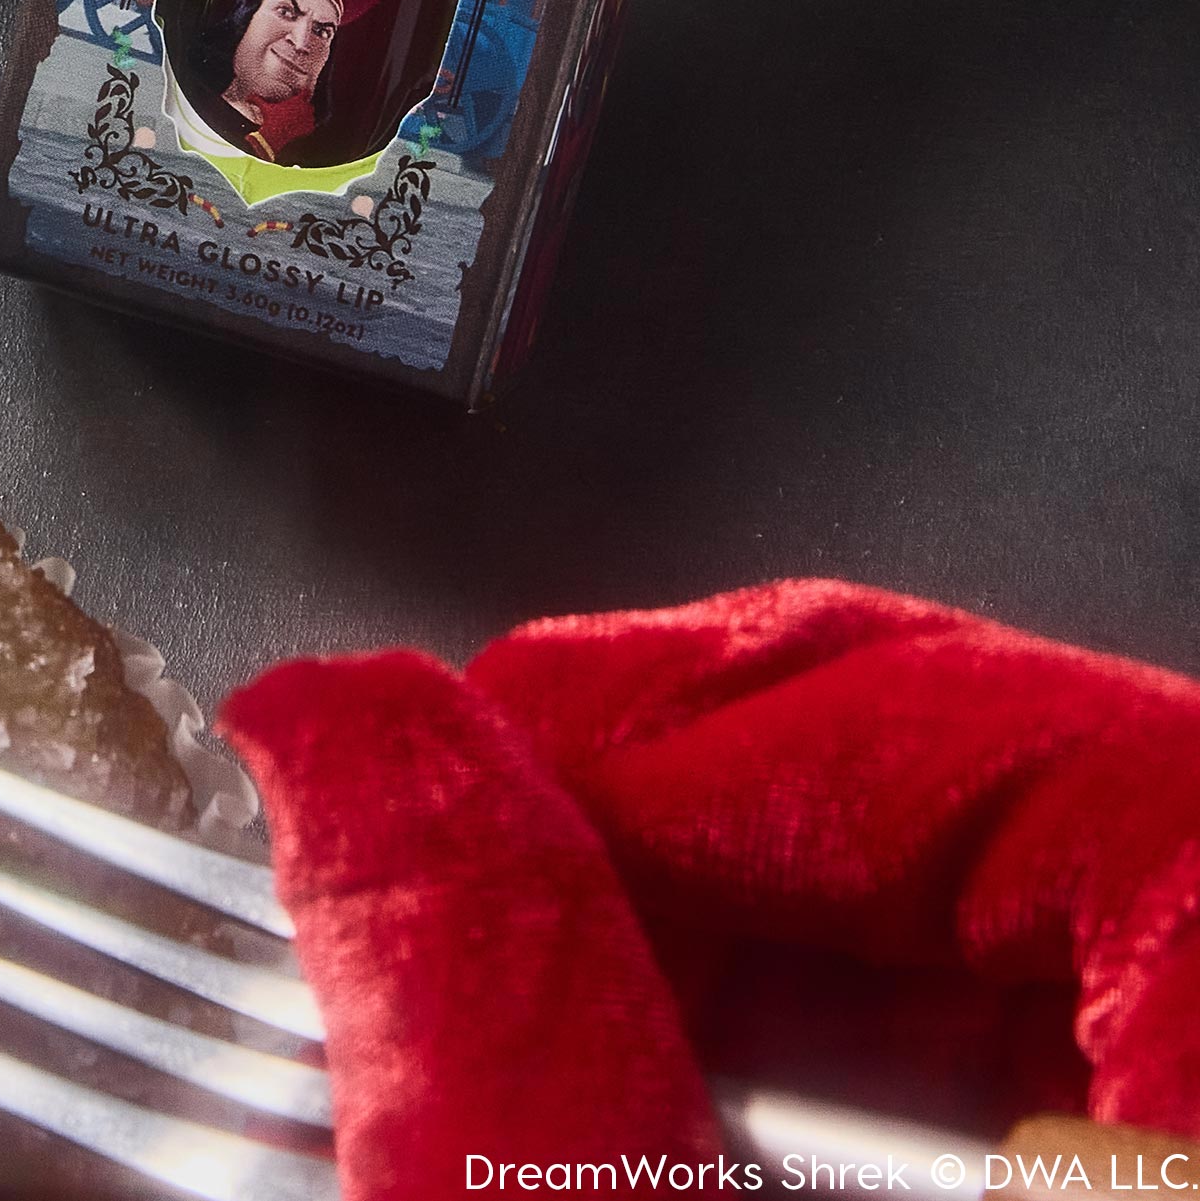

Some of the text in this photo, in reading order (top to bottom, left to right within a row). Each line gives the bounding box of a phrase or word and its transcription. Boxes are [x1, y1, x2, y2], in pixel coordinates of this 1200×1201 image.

[82, 203, 386, 313] ULTRA GLOSSY LIP
[90, 246, 130, 267] NET
[138, 257, 220, 294] WEIGHT
